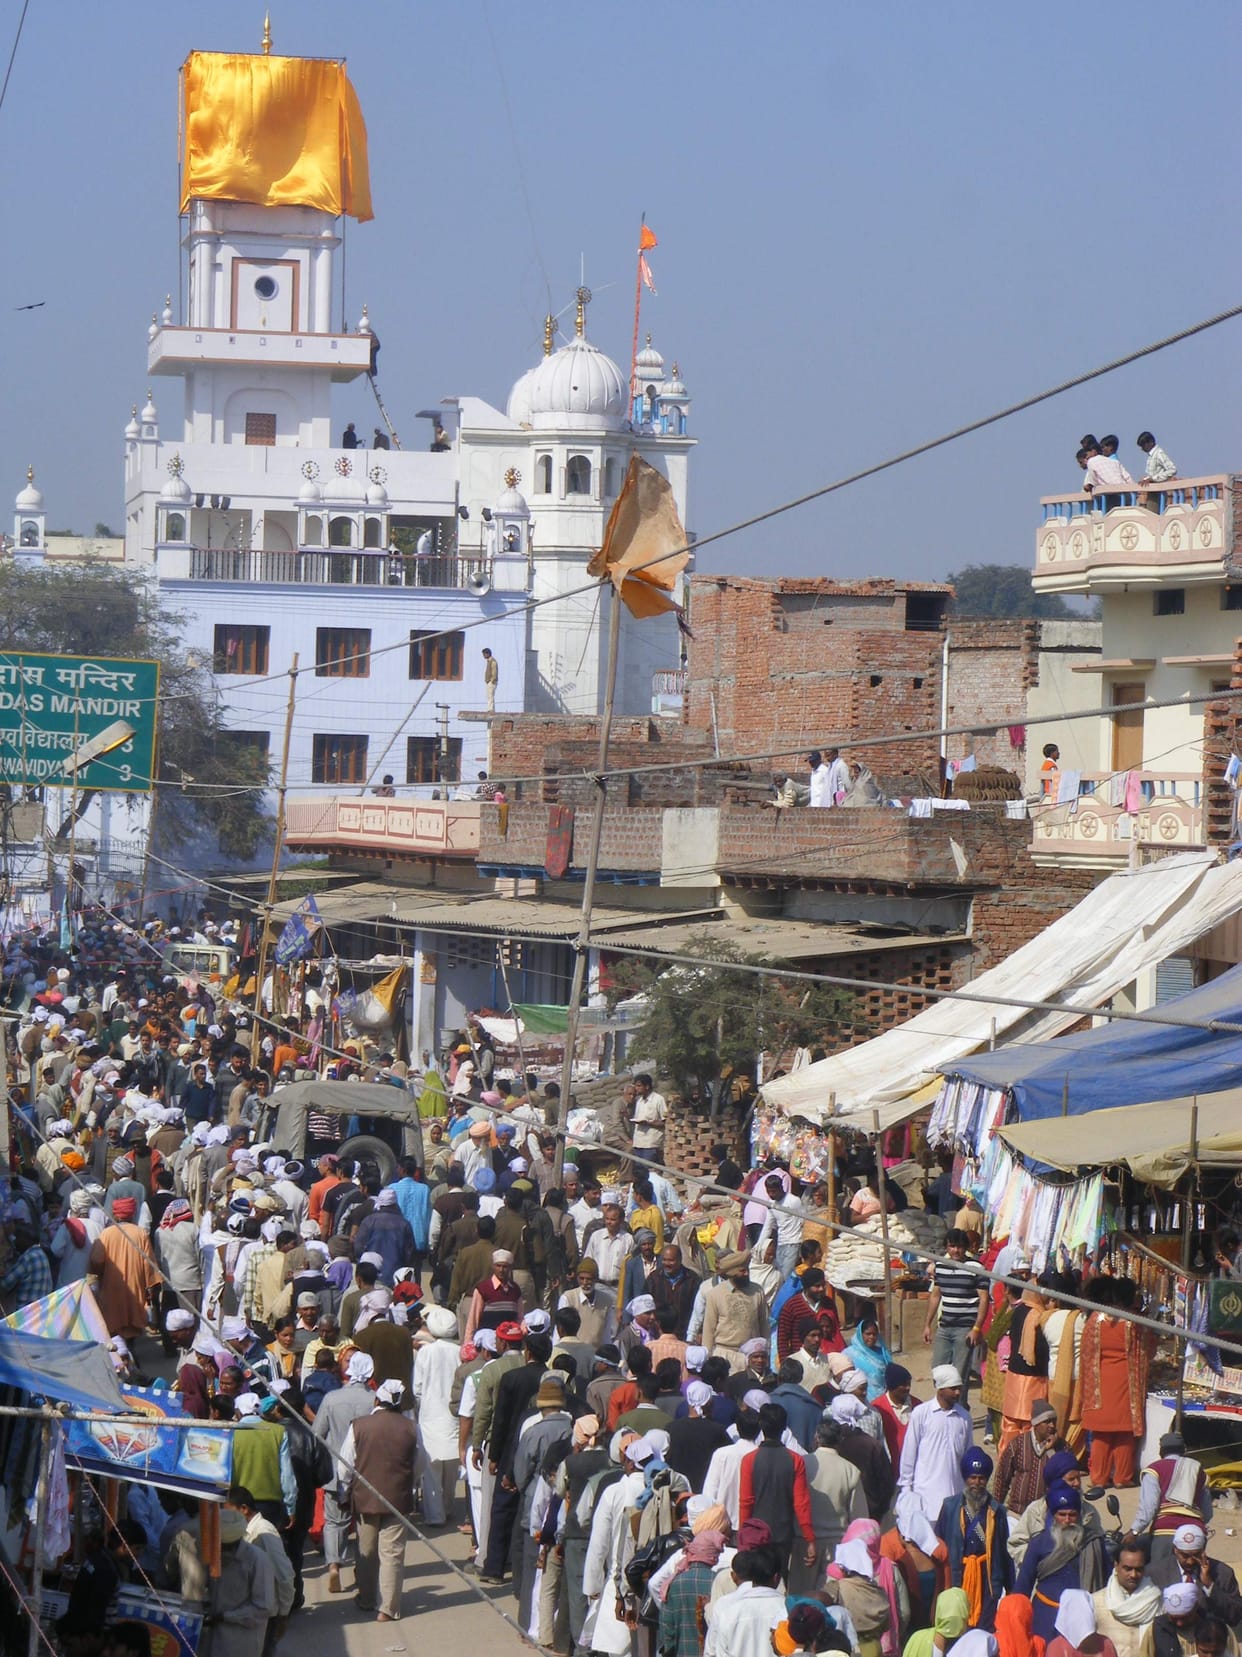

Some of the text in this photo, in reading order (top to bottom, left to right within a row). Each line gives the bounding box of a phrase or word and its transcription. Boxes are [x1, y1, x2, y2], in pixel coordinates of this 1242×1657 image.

[56, 663, 137, 691] मन्दिर
[51, 695, 141, 718] MANDIR
[119, 764, 133, 782] 3
